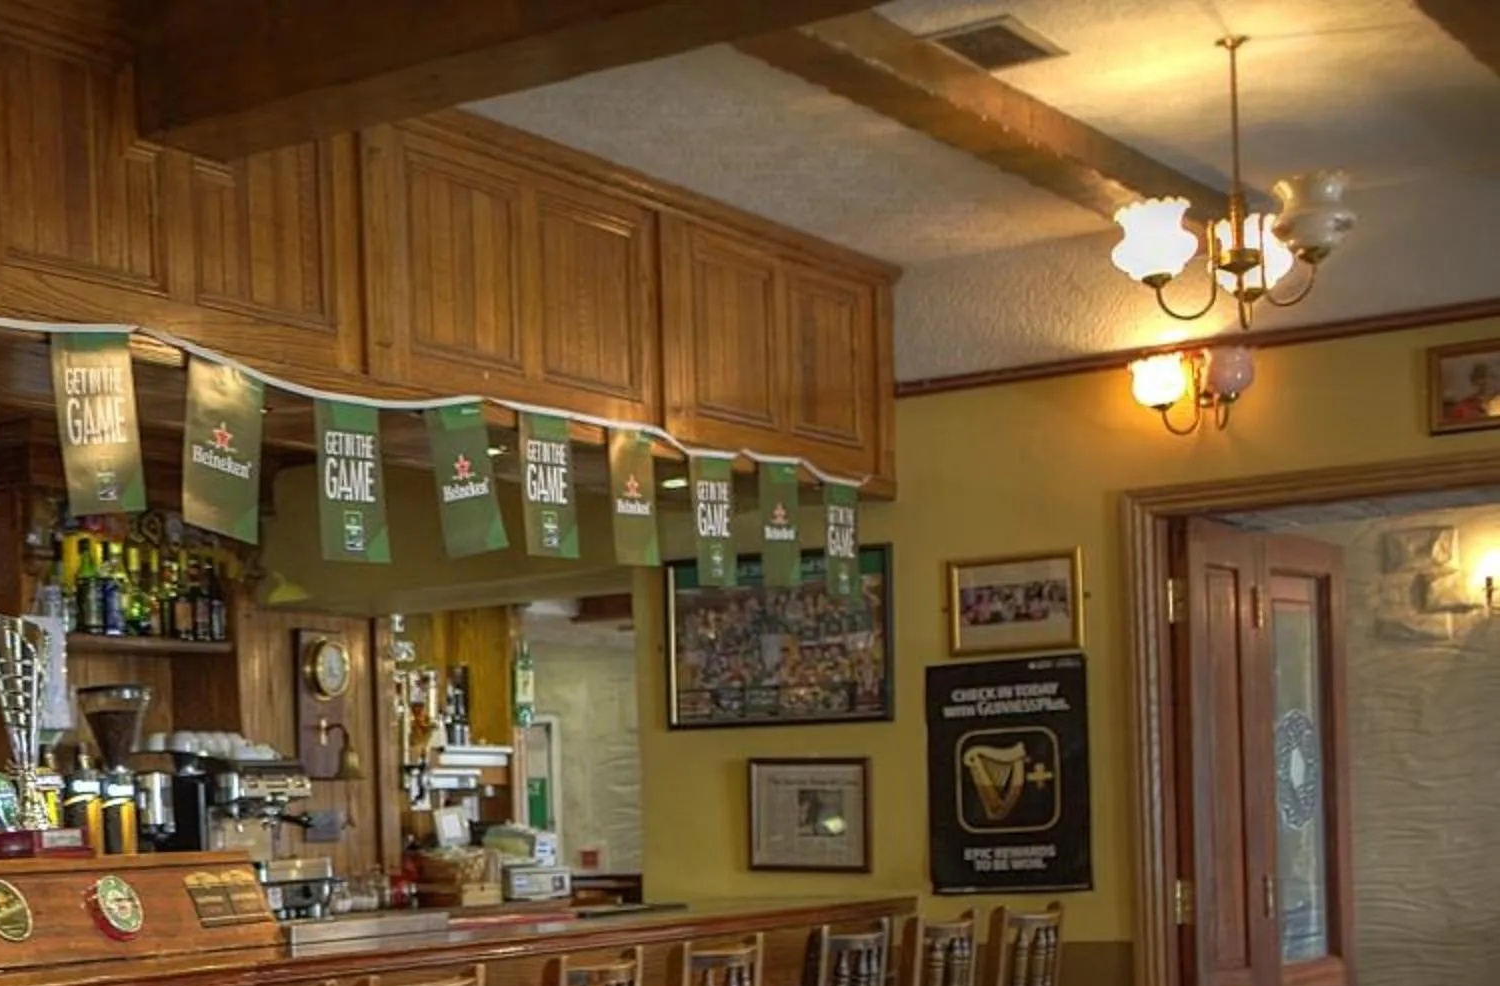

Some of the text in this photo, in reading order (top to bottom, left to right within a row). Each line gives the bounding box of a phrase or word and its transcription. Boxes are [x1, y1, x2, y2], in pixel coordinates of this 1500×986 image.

[65, 367, 124, 395] GET IN THE
[67, 396, 128, 445] GAME
[325, 431, 374, 458] GET IN THE
[527, 440, 566, 465] GET IN THE
[325, 457, 376, 502] GAME
[527, 463, 568, 504] GAME
[697, 502, 730, 537] GAME
[827, 525, 855, 558] GAME
[951, 686, 997, 702] CHECK
[1015, 682, 1059, 697] TODAY
